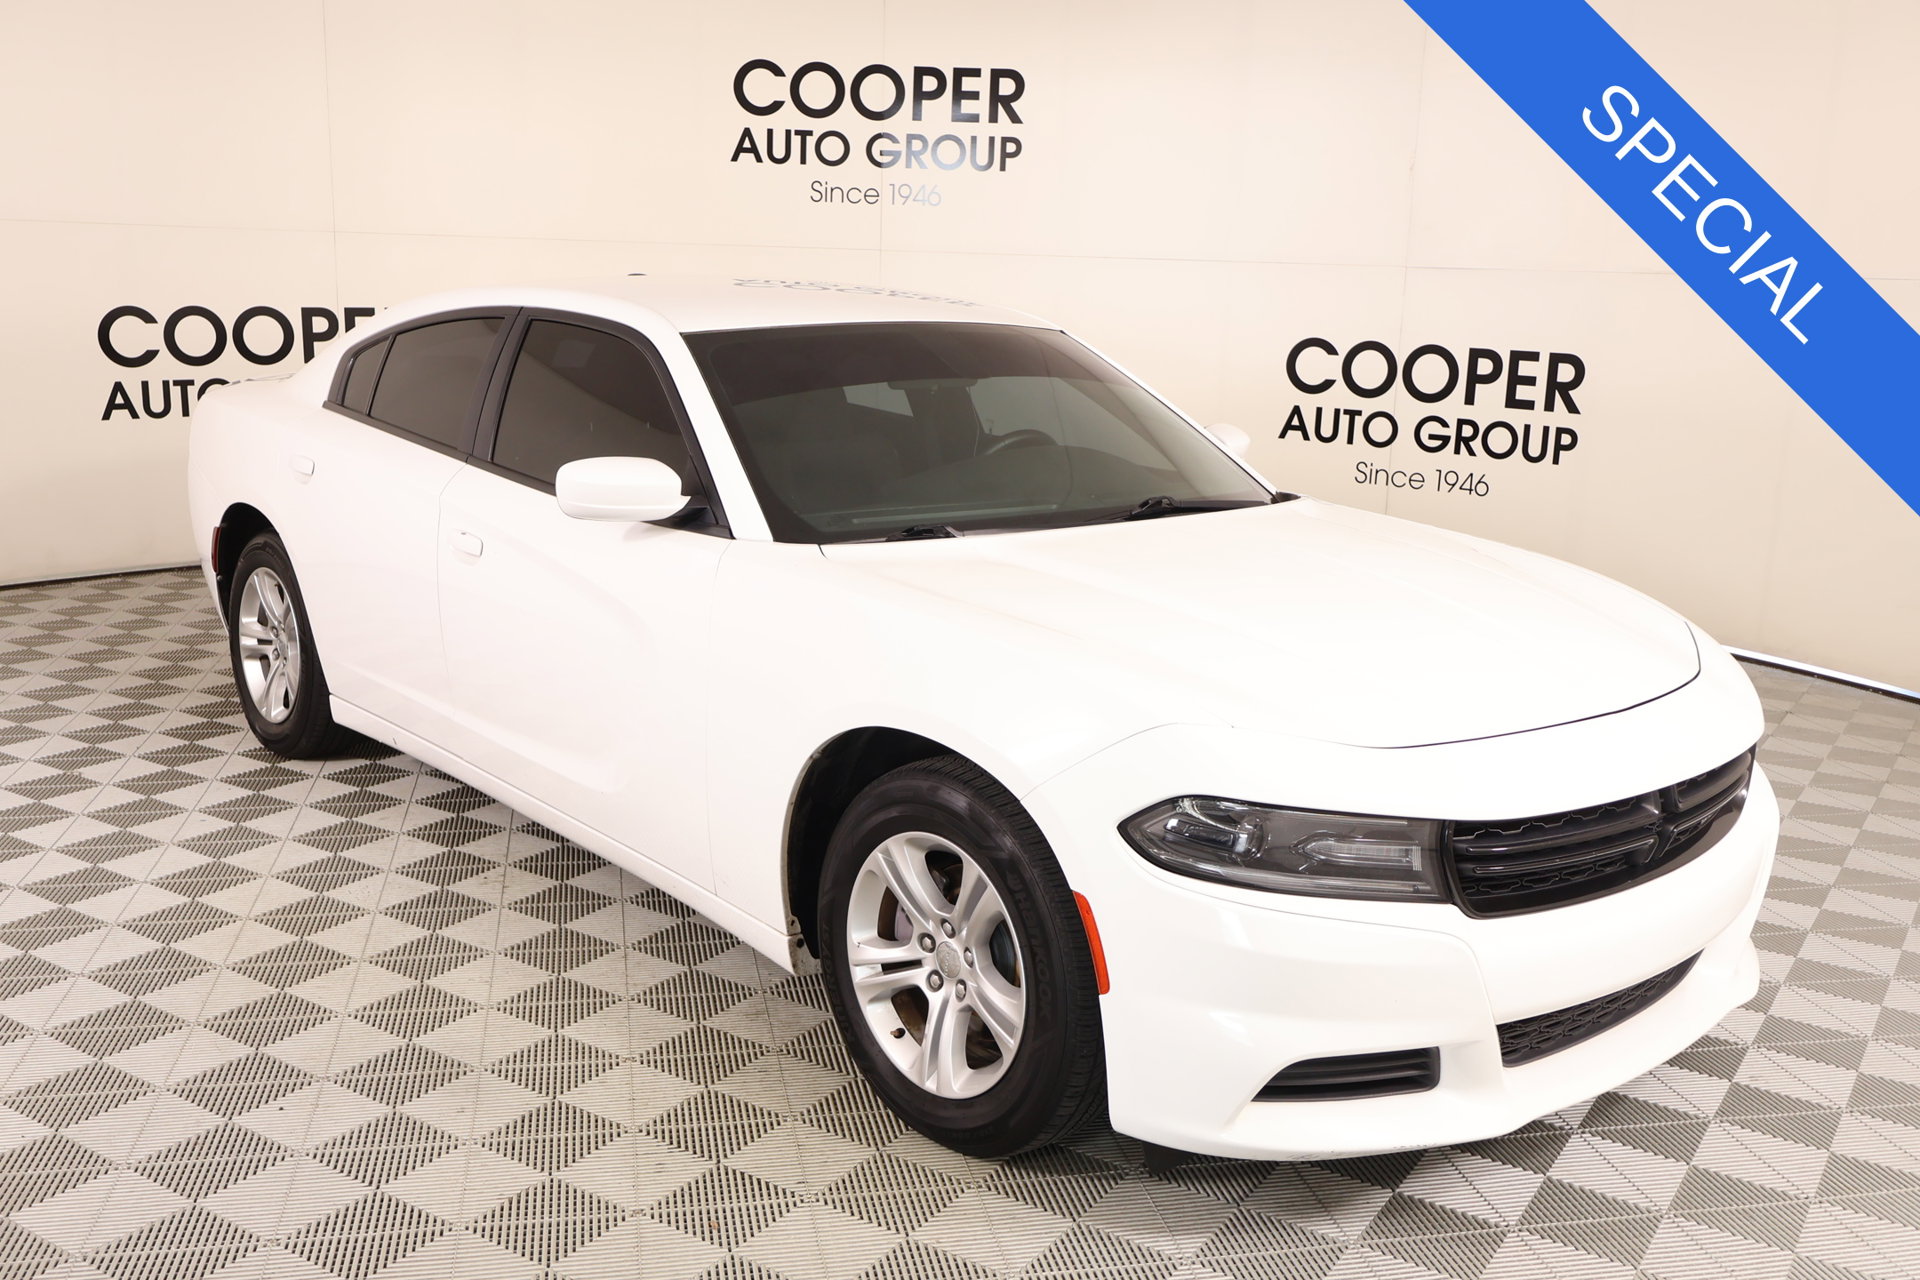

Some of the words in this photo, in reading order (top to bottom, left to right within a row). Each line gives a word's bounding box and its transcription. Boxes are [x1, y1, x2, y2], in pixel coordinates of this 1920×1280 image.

[733, 59, 1026, 124] COOPER
[730, 127, 851, 167] AUTO
[865, 132, 1023, 171] GROUP
[810, 180, 880, 205] Since
[888, 183, 942, 206] 1946
[97, 305, 388, 367] COOP
[101, 378, 230, 420] AUT
[1286, 337, 1586, 415] COOPER
[1278, 405, 1399, 448] AUTO
[1413, 415, 1579, 465] GROUP
[1354, 461, 1425, 490] Since
[1435, 469, 1490, 497] 1946
